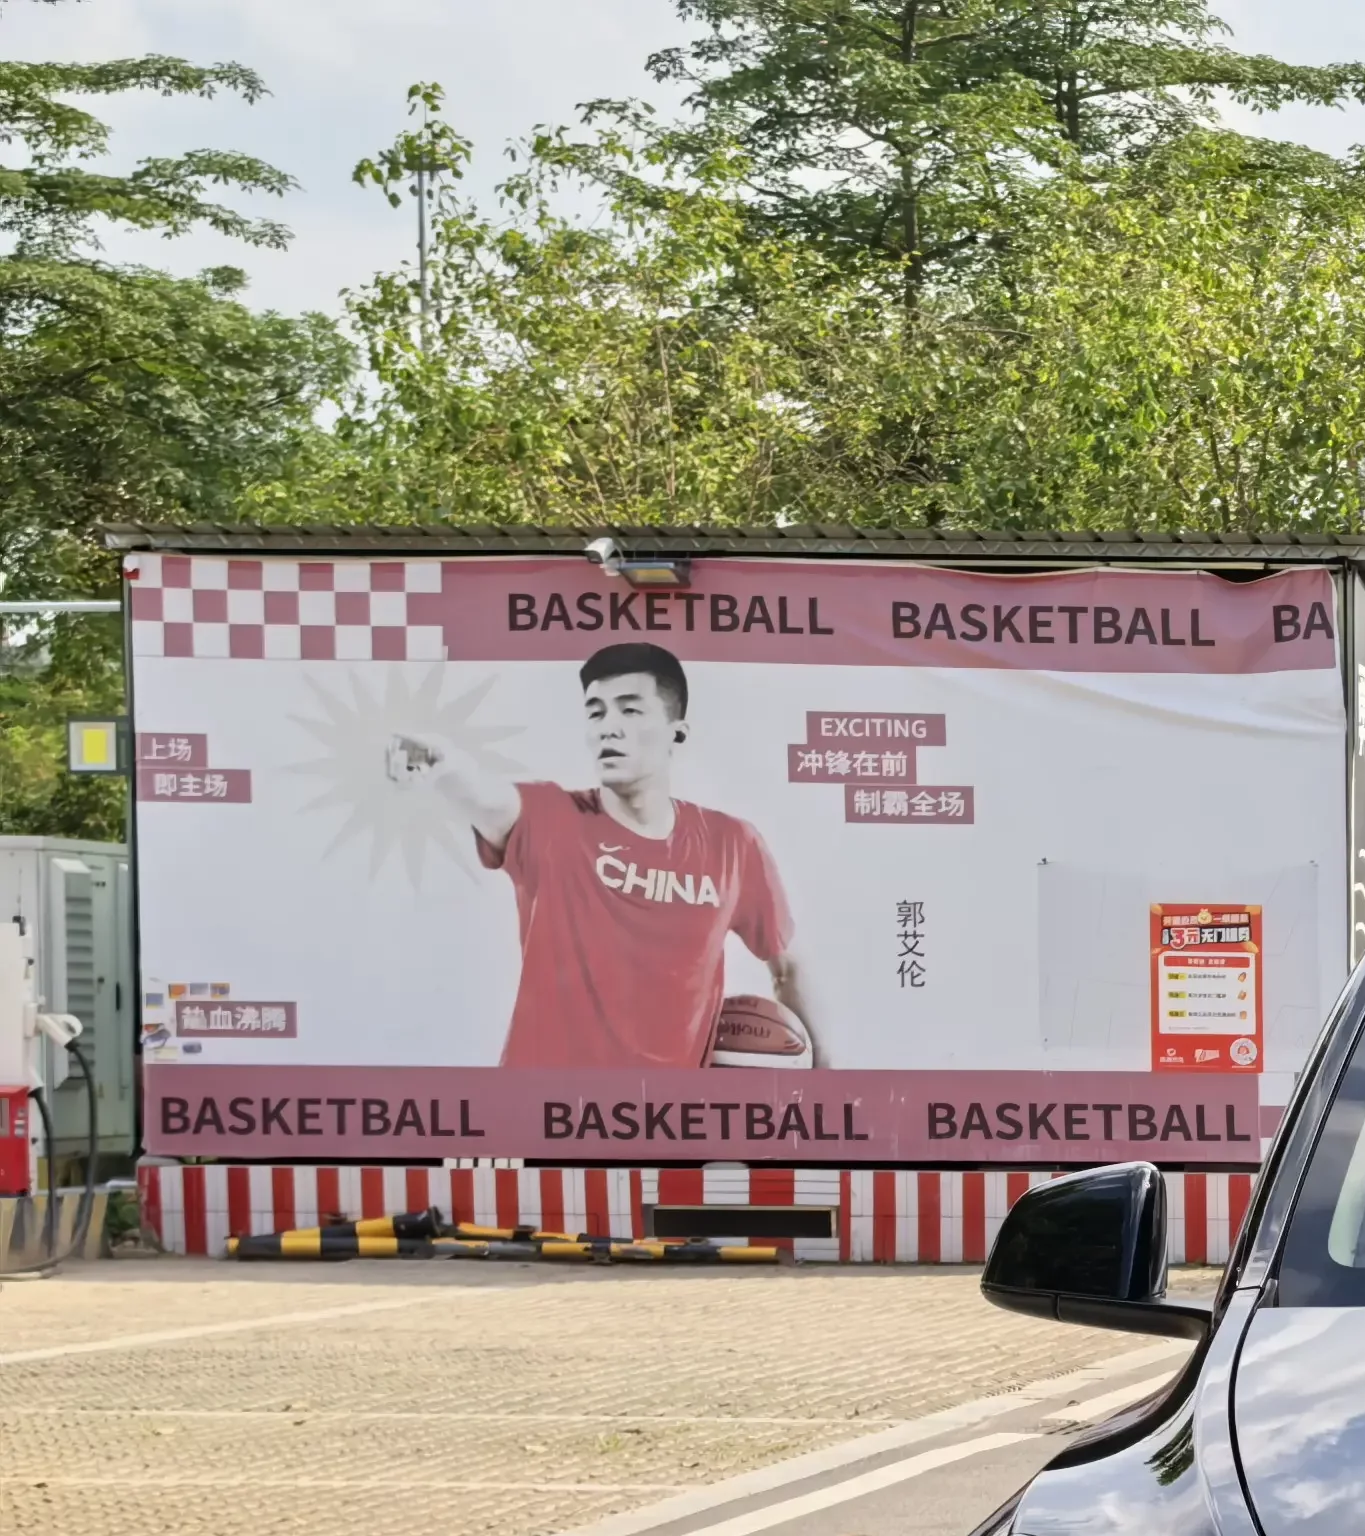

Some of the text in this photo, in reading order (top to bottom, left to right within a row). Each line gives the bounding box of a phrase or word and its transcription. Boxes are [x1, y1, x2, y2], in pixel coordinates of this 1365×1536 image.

[508, 592, 1335, 647] BASKETBALL BASKETBALL BA
[820, 717, 927, 738] EXCITING
[143, 738, 192, 761] 上场
[797, 749, 908, 777] 冲锋在前
[154, 773, 228, 797] 即主场
[853, 789, 965, 817] 制霸全场
[596, 854, 720, 908] CHINA
[896, 899, 926, 988] 郭艾伦
[181, 1006, 287, 1031] 热血沸腾
[160, 1096, 1251, 1142] BASKETBALL BASKETBALL BASKETBALL
